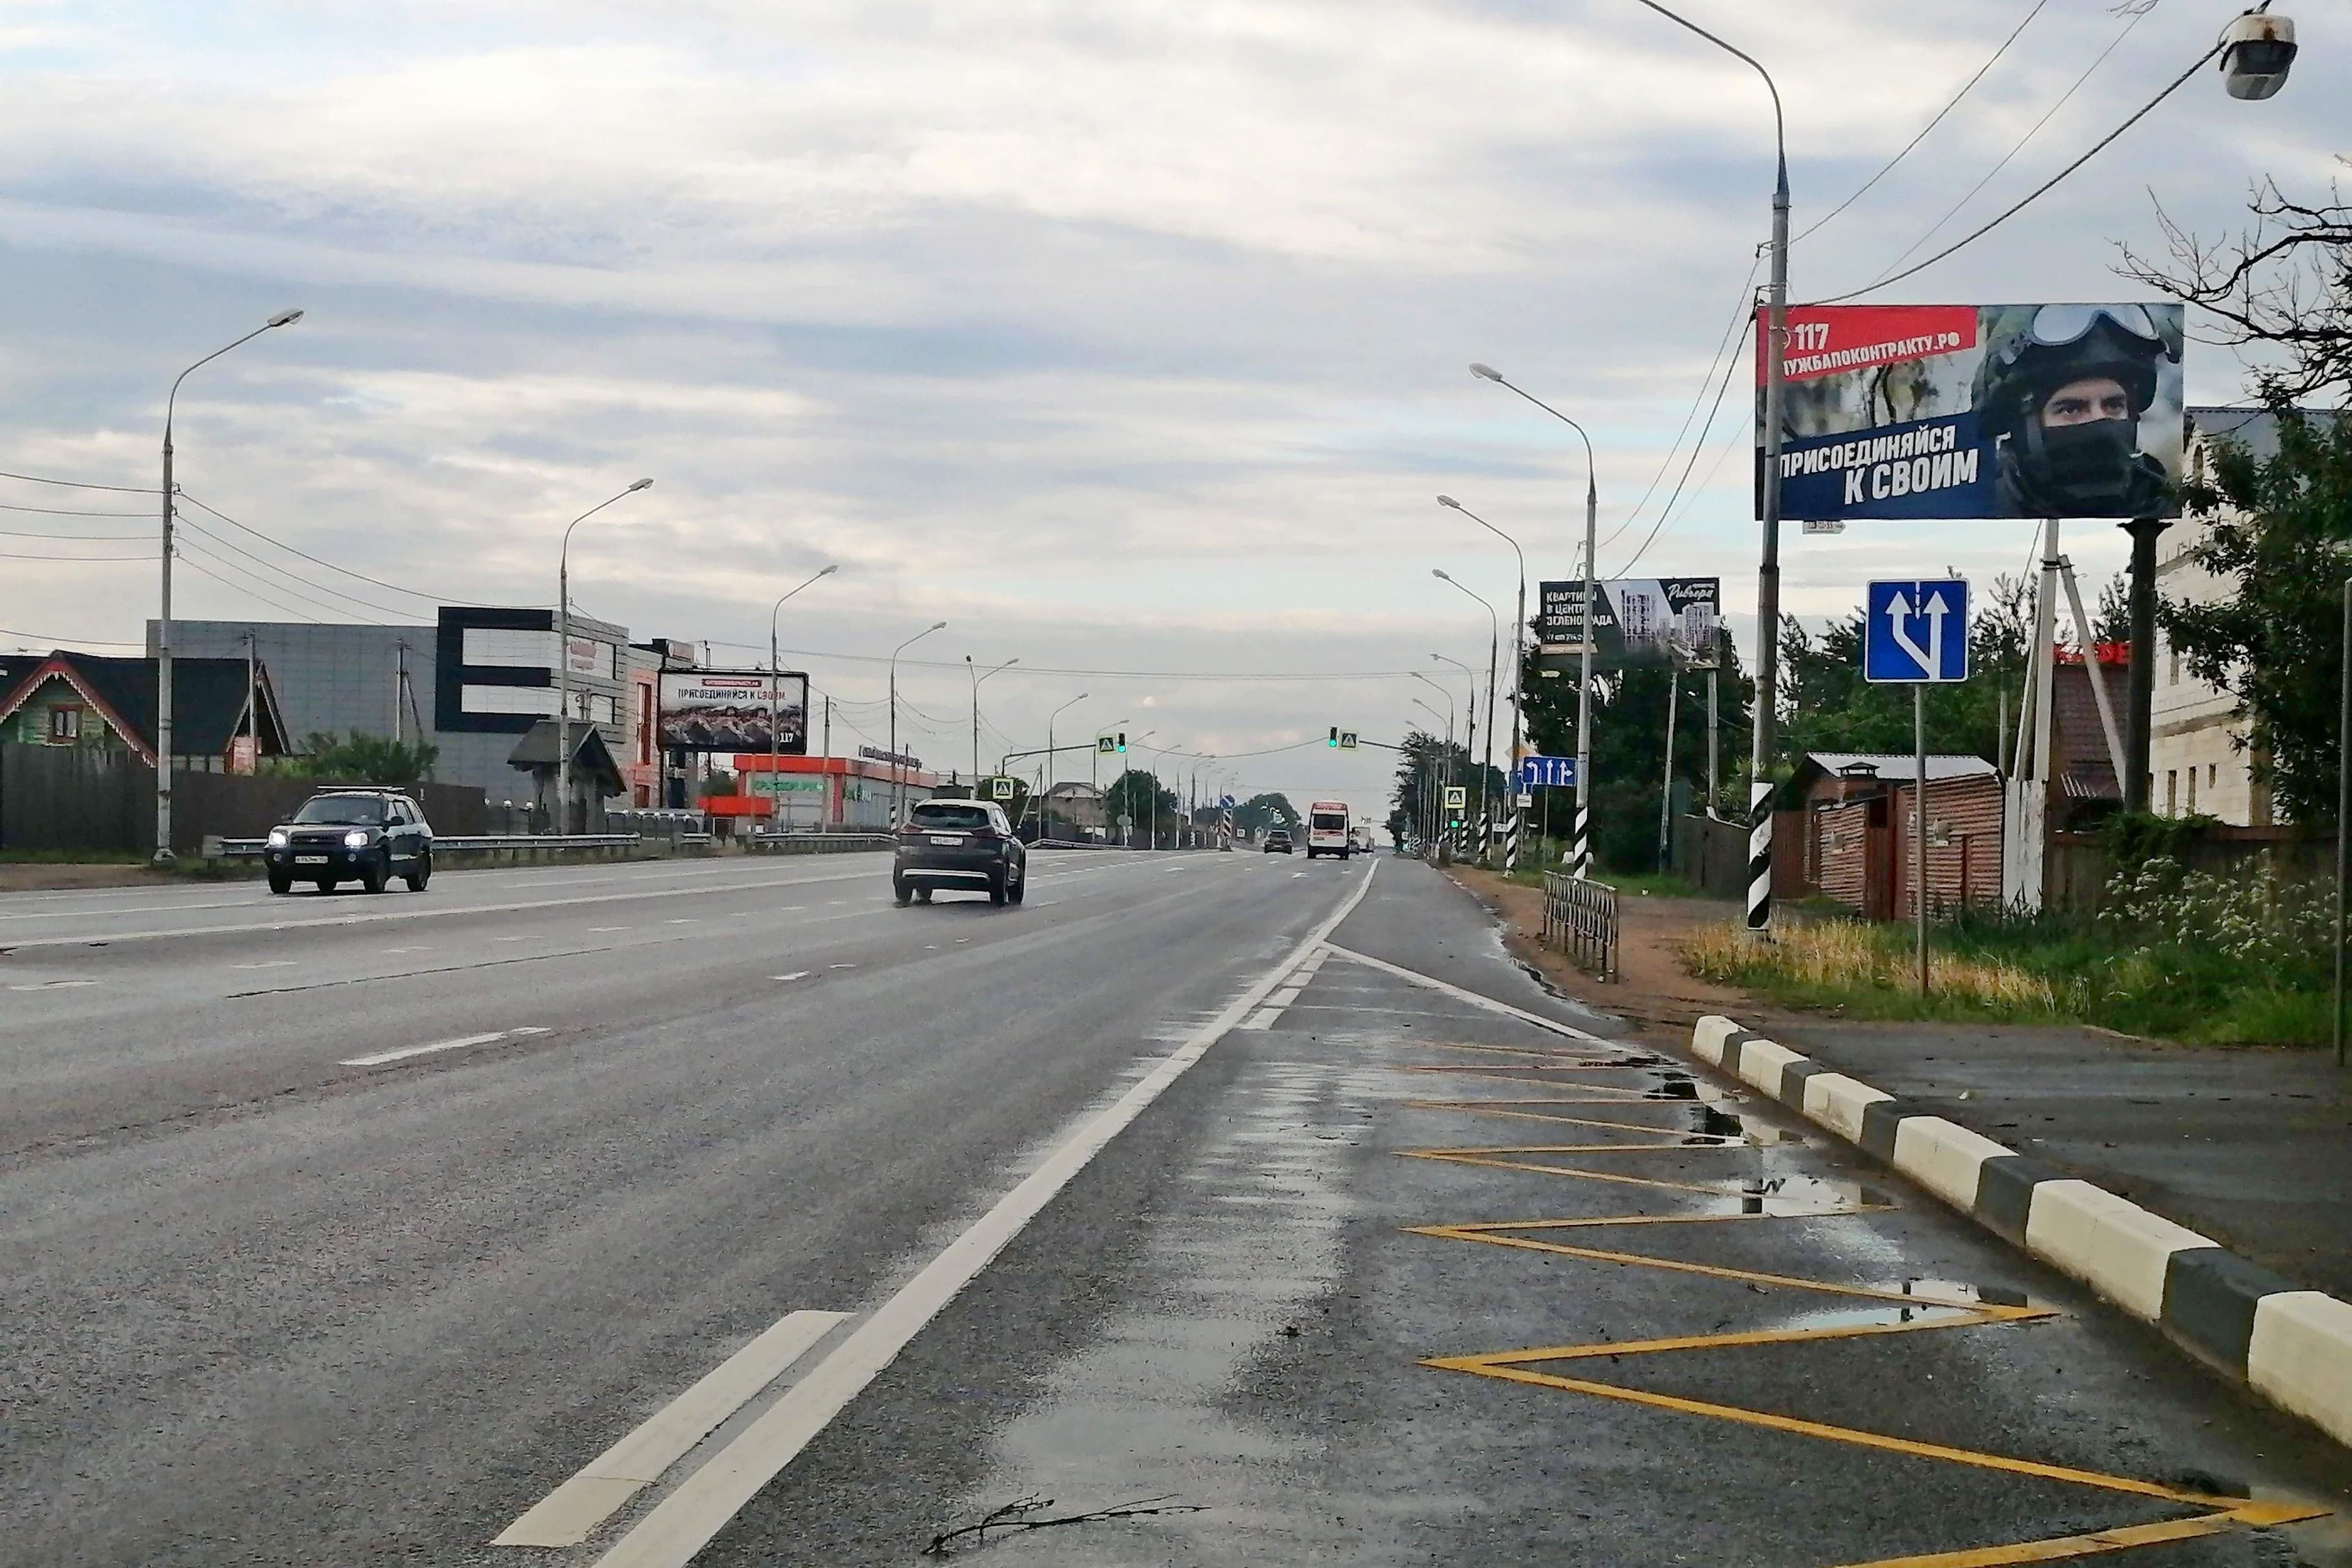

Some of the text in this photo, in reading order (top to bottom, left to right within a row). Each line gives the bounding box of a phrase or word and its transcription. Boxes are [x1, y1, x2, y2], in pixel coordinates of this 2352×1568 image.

[1794, 323, 1830, 351] 117
[1784, 331, 1961, 377] УЖБАПОКОНТРАКТУ.РФ
[1779, 424, 1956, 479] ПРИСОЕДИНЯЙСЯ
[1844, 448, 1979, 505] К СВОИМ
[1546, 591, 1597, 603] КВАРТИЫ
[1546, 615, 1613, 627] ЗЕЛЕНОАДА
[779, 732, 794, 743] 117
